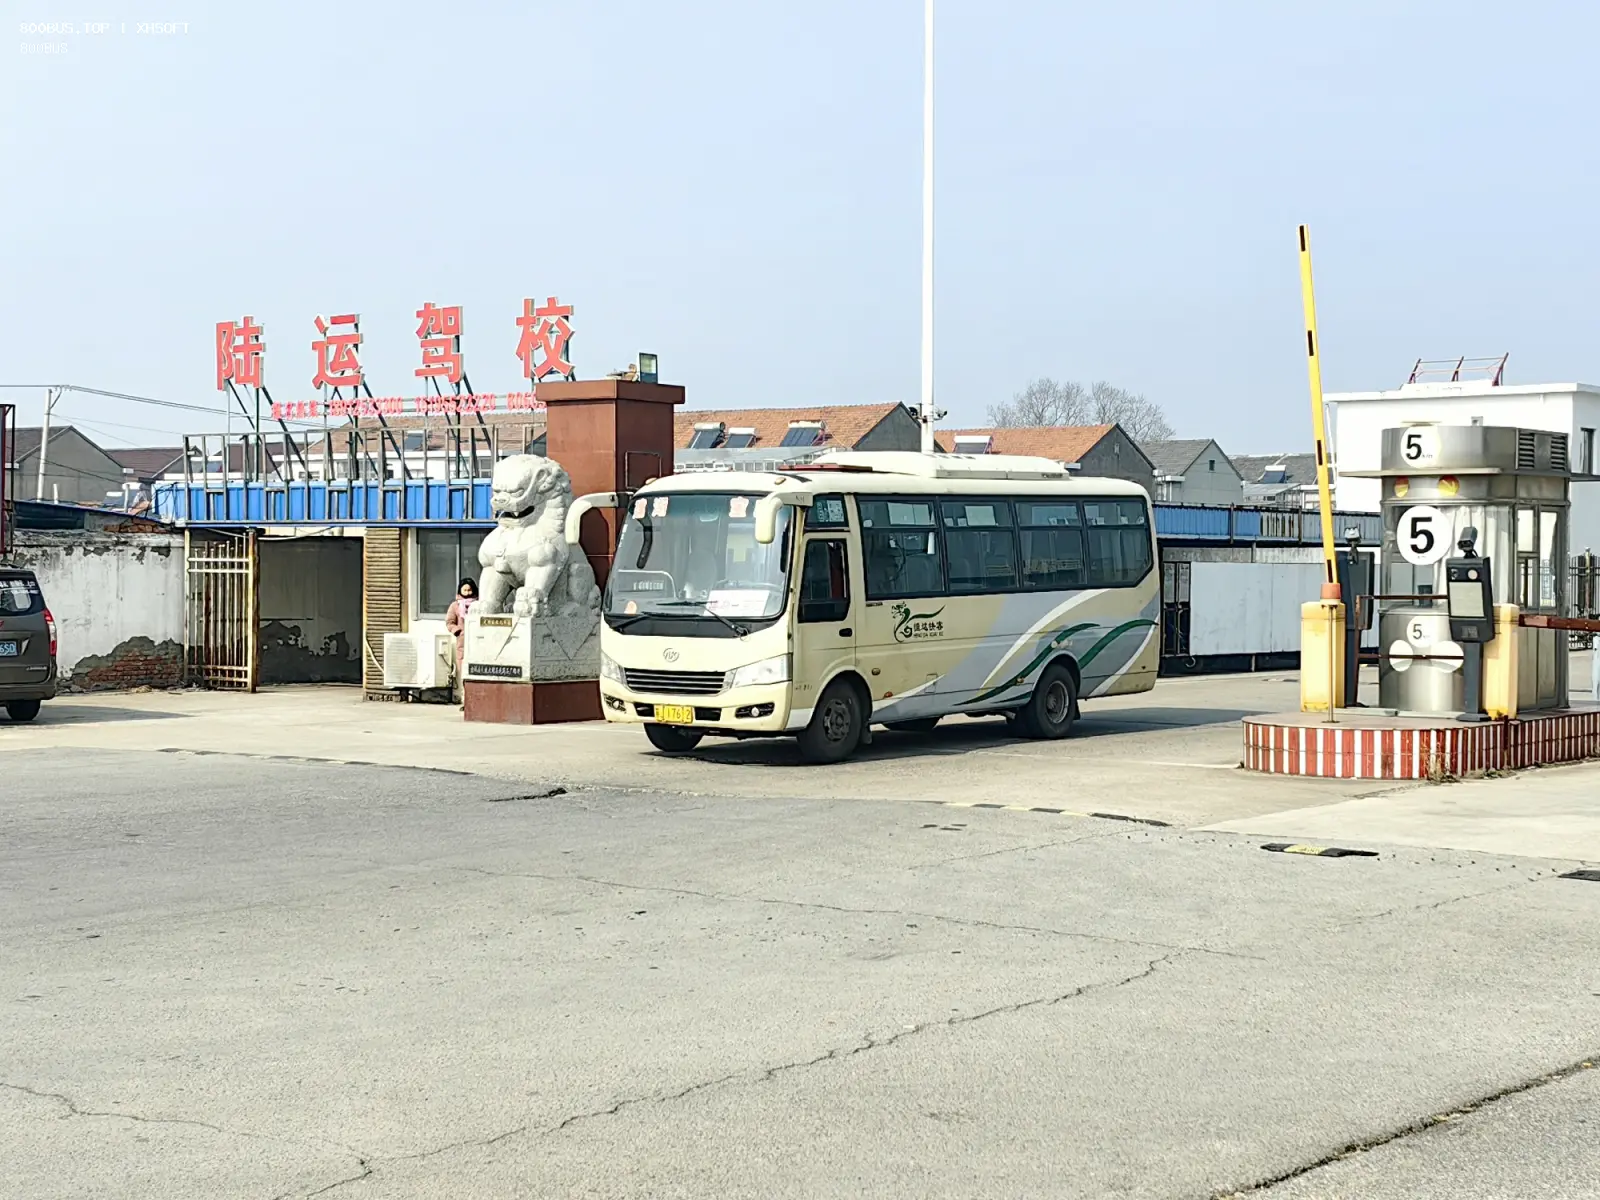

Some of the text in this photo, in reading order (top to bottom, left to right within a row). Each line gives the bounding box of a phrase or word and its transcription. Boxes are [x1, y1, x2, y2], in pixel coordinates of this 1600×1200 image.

[215, 296, 575, 391] 陆运驾校
[1406, 434, 1422, 460] 5
[1410, 516, 1435, 554] 5
[1412, 623, 1423, 640] 5
